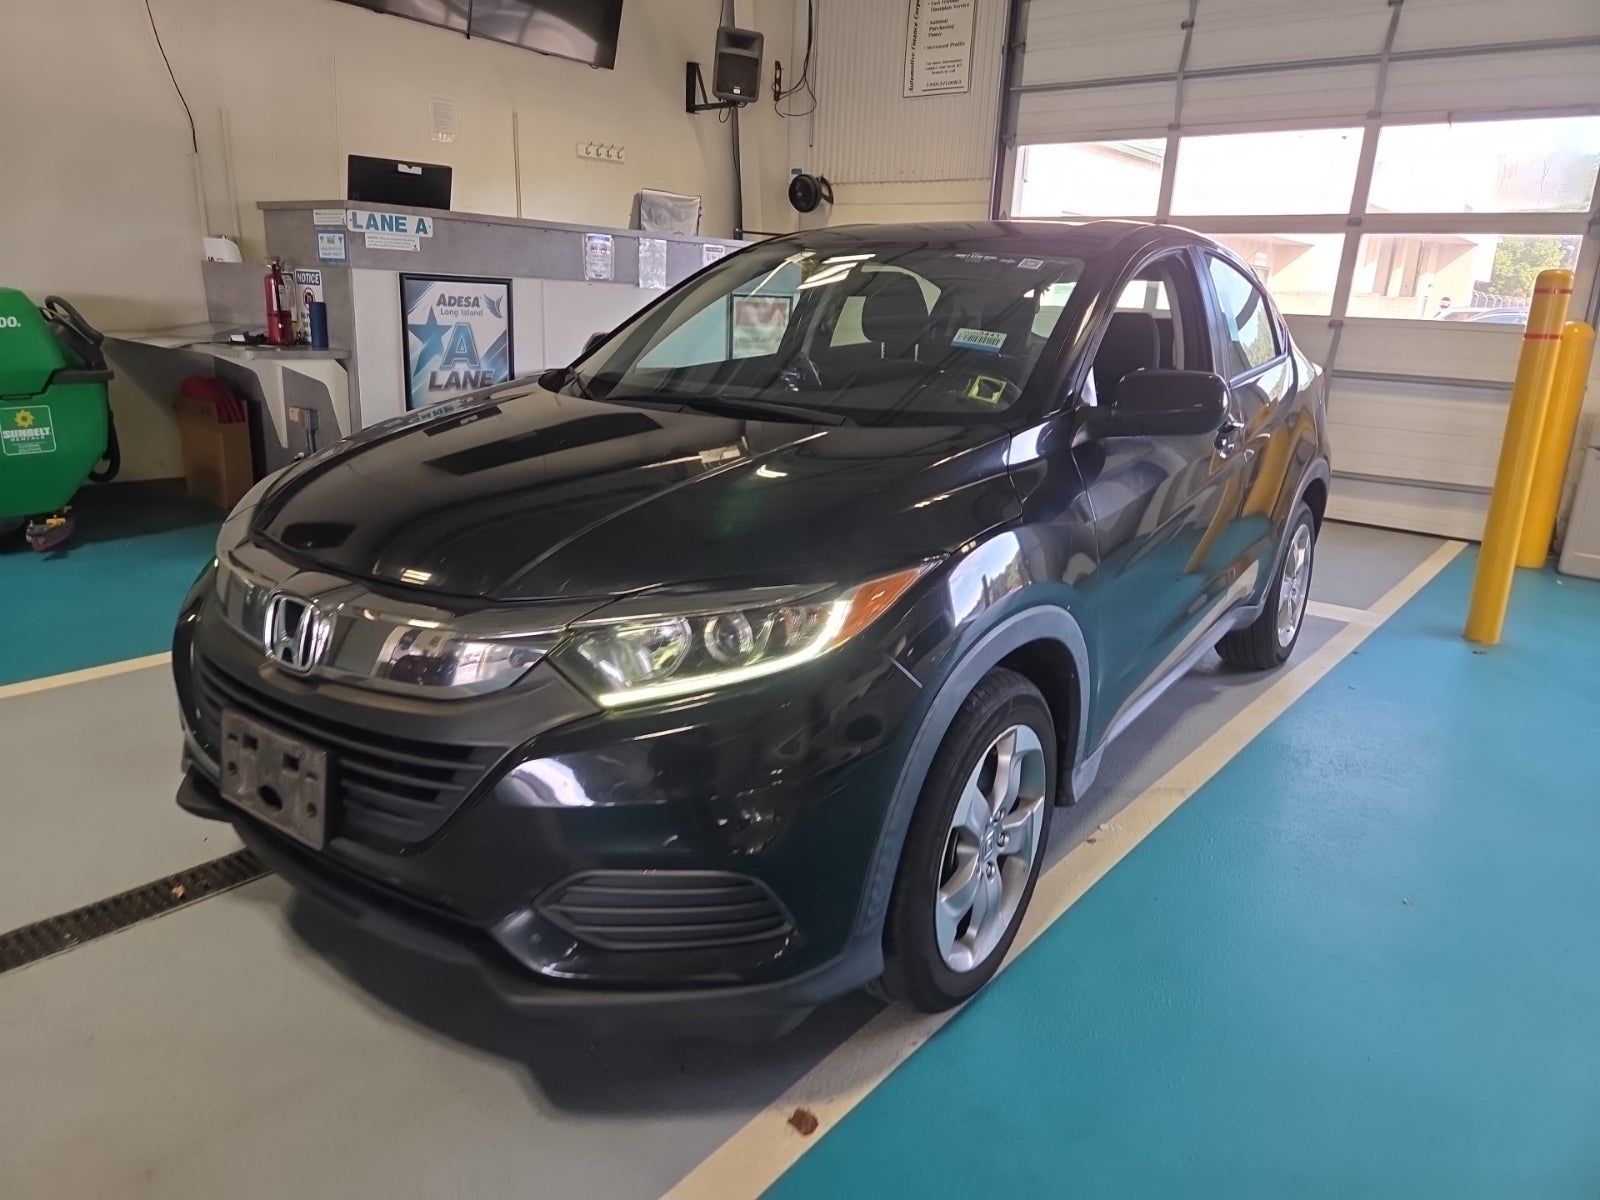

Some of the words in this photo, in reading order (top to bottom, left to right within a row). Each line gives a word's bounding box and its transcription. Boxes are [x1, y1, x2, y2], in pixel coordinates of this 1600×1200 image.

[351, 211, 407, 233] LANE
[415, 217, 428, 235] A
[297, 272, 319, 284] NOTICE
[436, 293, 480, 308] ADESA
[440, 308, 459, 317] Long
[461, 308, 483, 317] Island
[439, 321, 482, 371] A
[428, 369, 495, 392] LANE
[2, 427, 50, 439] SUNBELT
